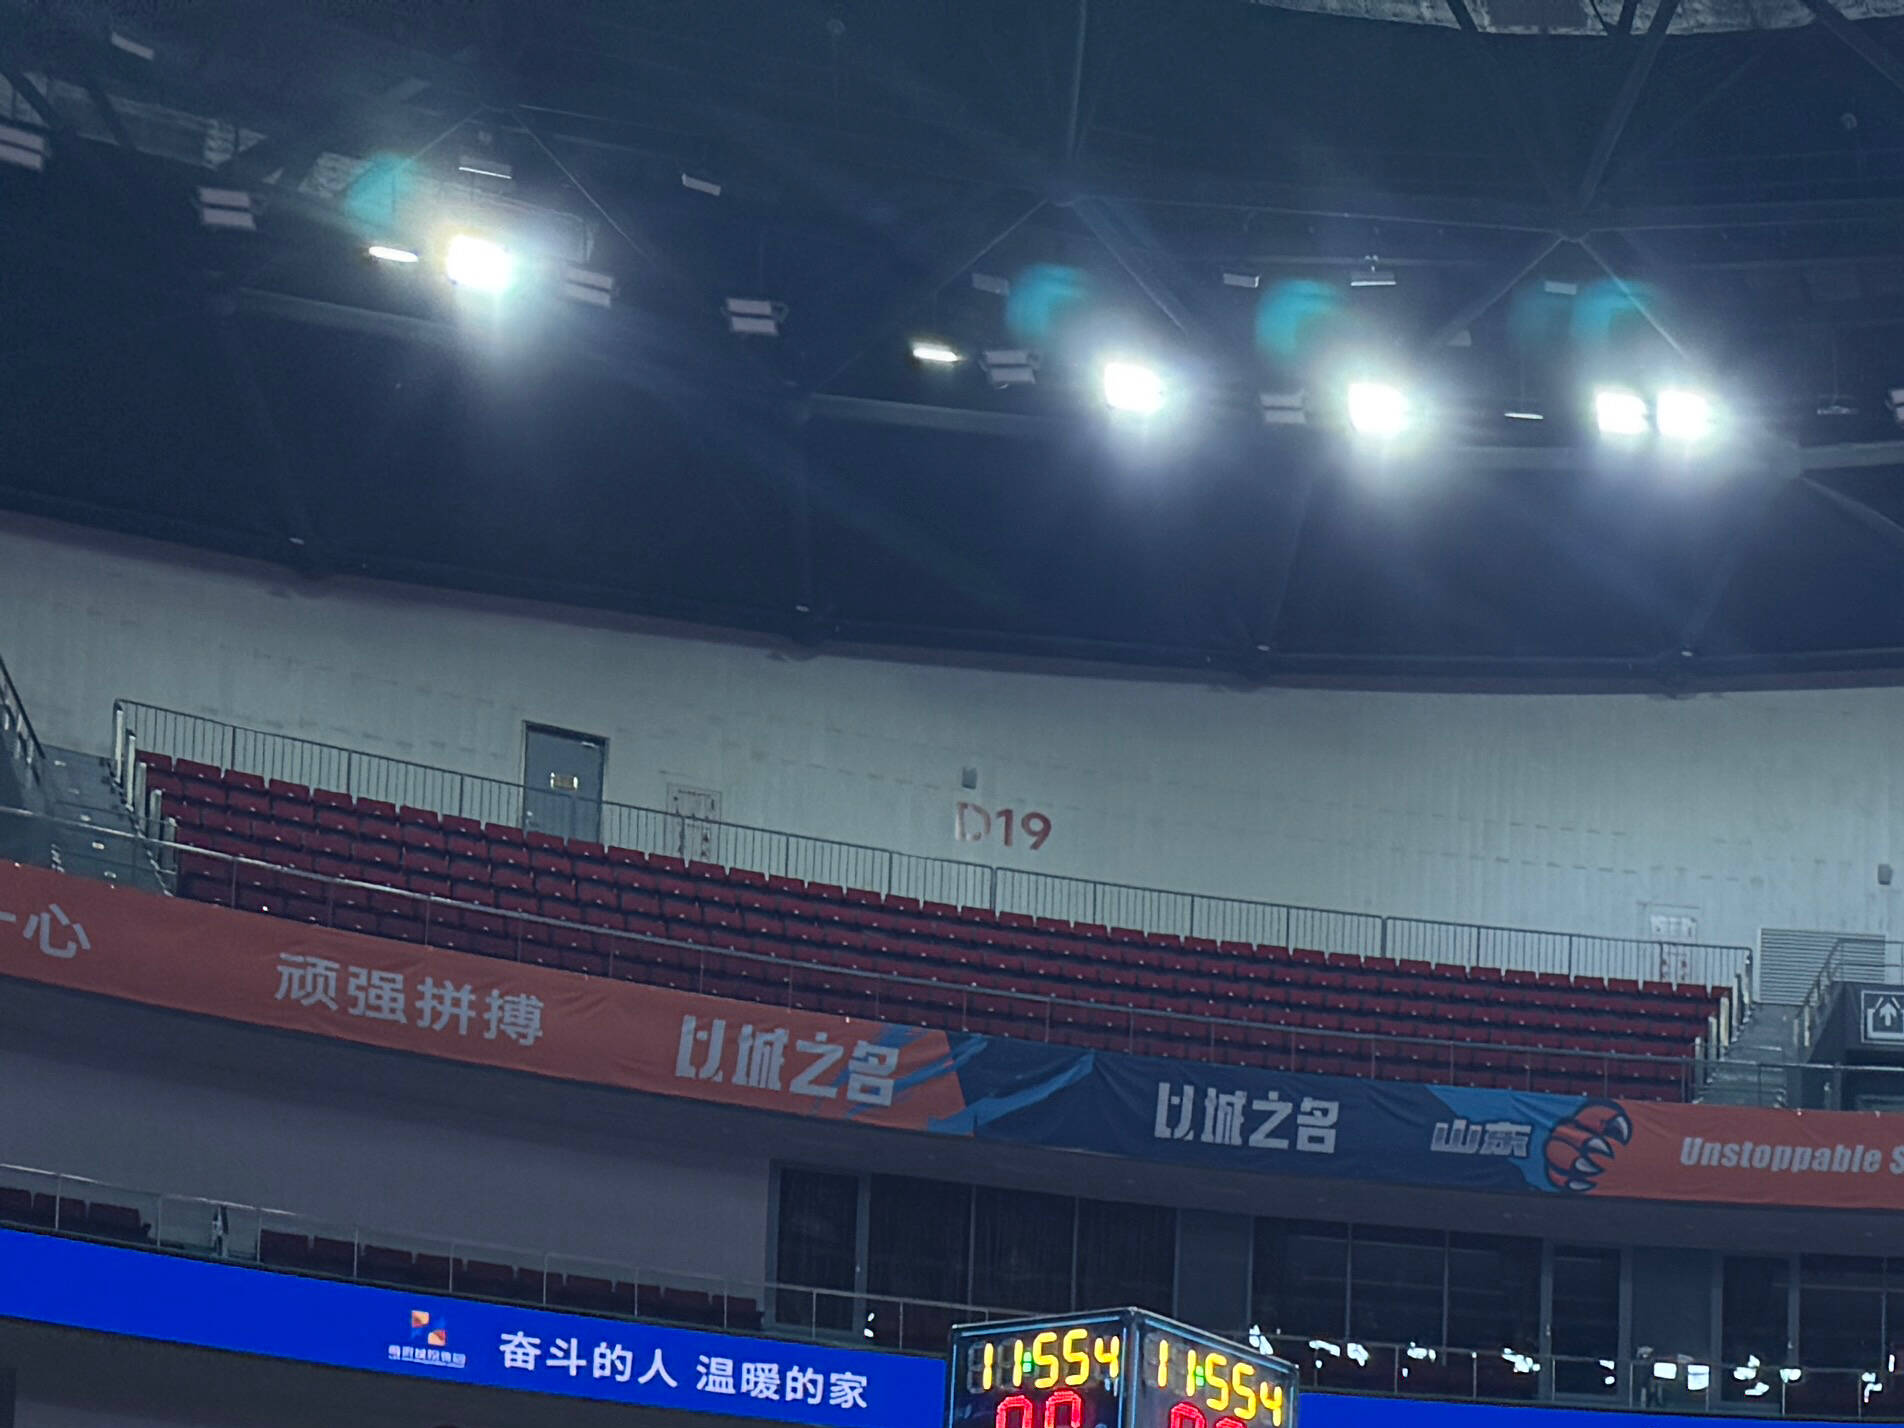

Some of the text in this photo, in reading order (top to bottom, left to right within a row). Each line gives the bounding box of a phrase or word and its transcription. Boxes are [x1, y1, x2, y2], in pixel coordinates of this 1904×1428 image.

[955, 802, 1052, 851] D19
[0, 904, 543, 1048] 心 顽强拼搏
[675, 1014, 900, 1105] 以城之名
[1154, 1083, 1340, 1154] 以城之名
[1680, 1136, 1880, 1175] Unstoppable
[499, 1331, 869, 1411] 奋斗的人 温暖的家
